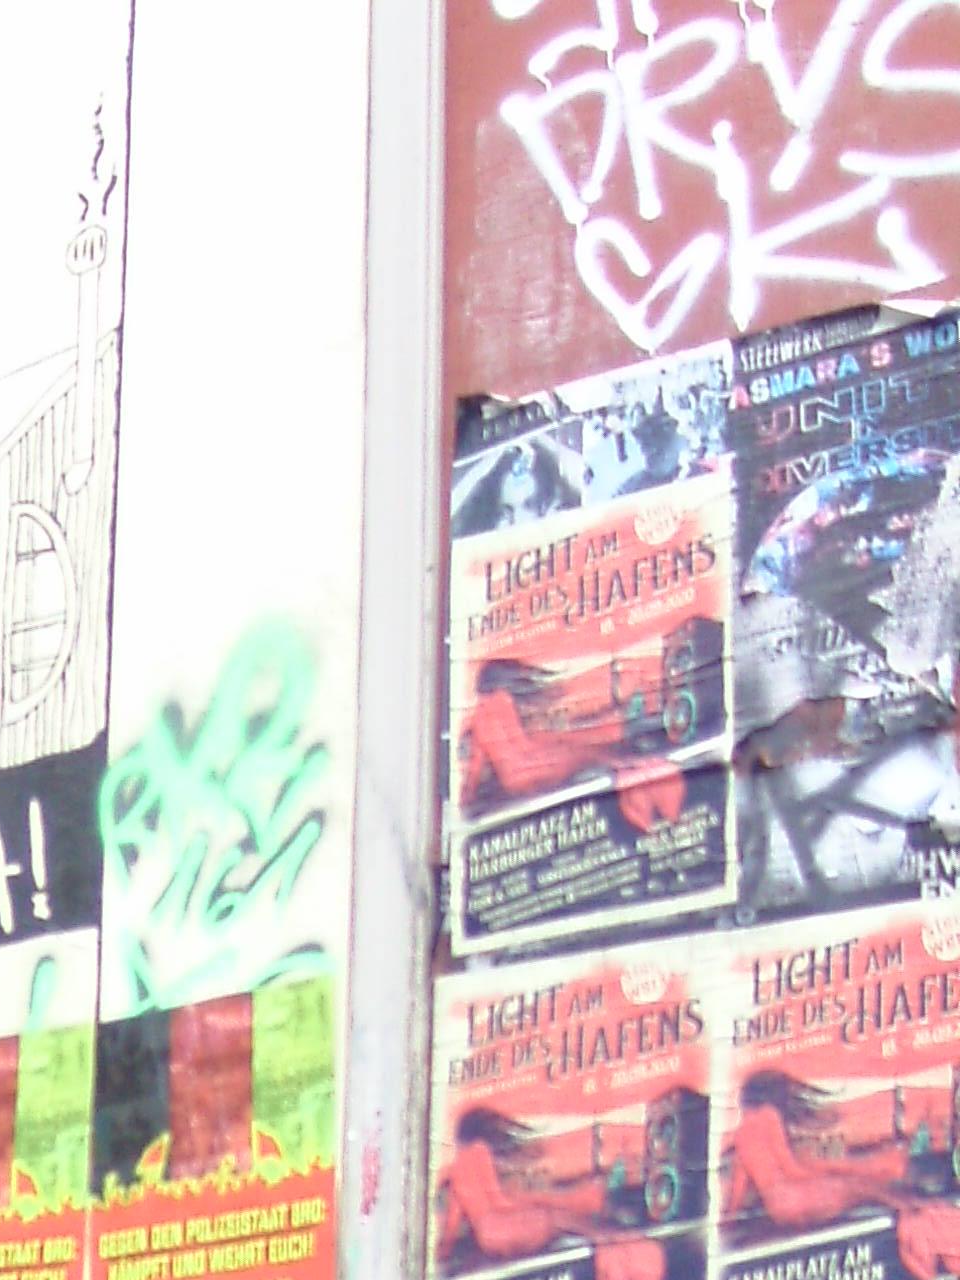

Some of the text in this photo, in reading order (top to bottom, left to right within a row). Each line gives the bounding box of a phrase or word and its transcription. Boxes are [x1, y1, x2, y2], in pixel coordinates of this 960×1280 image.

[486, 531, 619, 601] LICHT AM
[563, 533, 717, 627] HAFENS
[753, 938, 904, 1006] LICHT AM
[467, 983, 604, 1048] LICHT AM
[546, 998, 705, 1084] HAFENS
